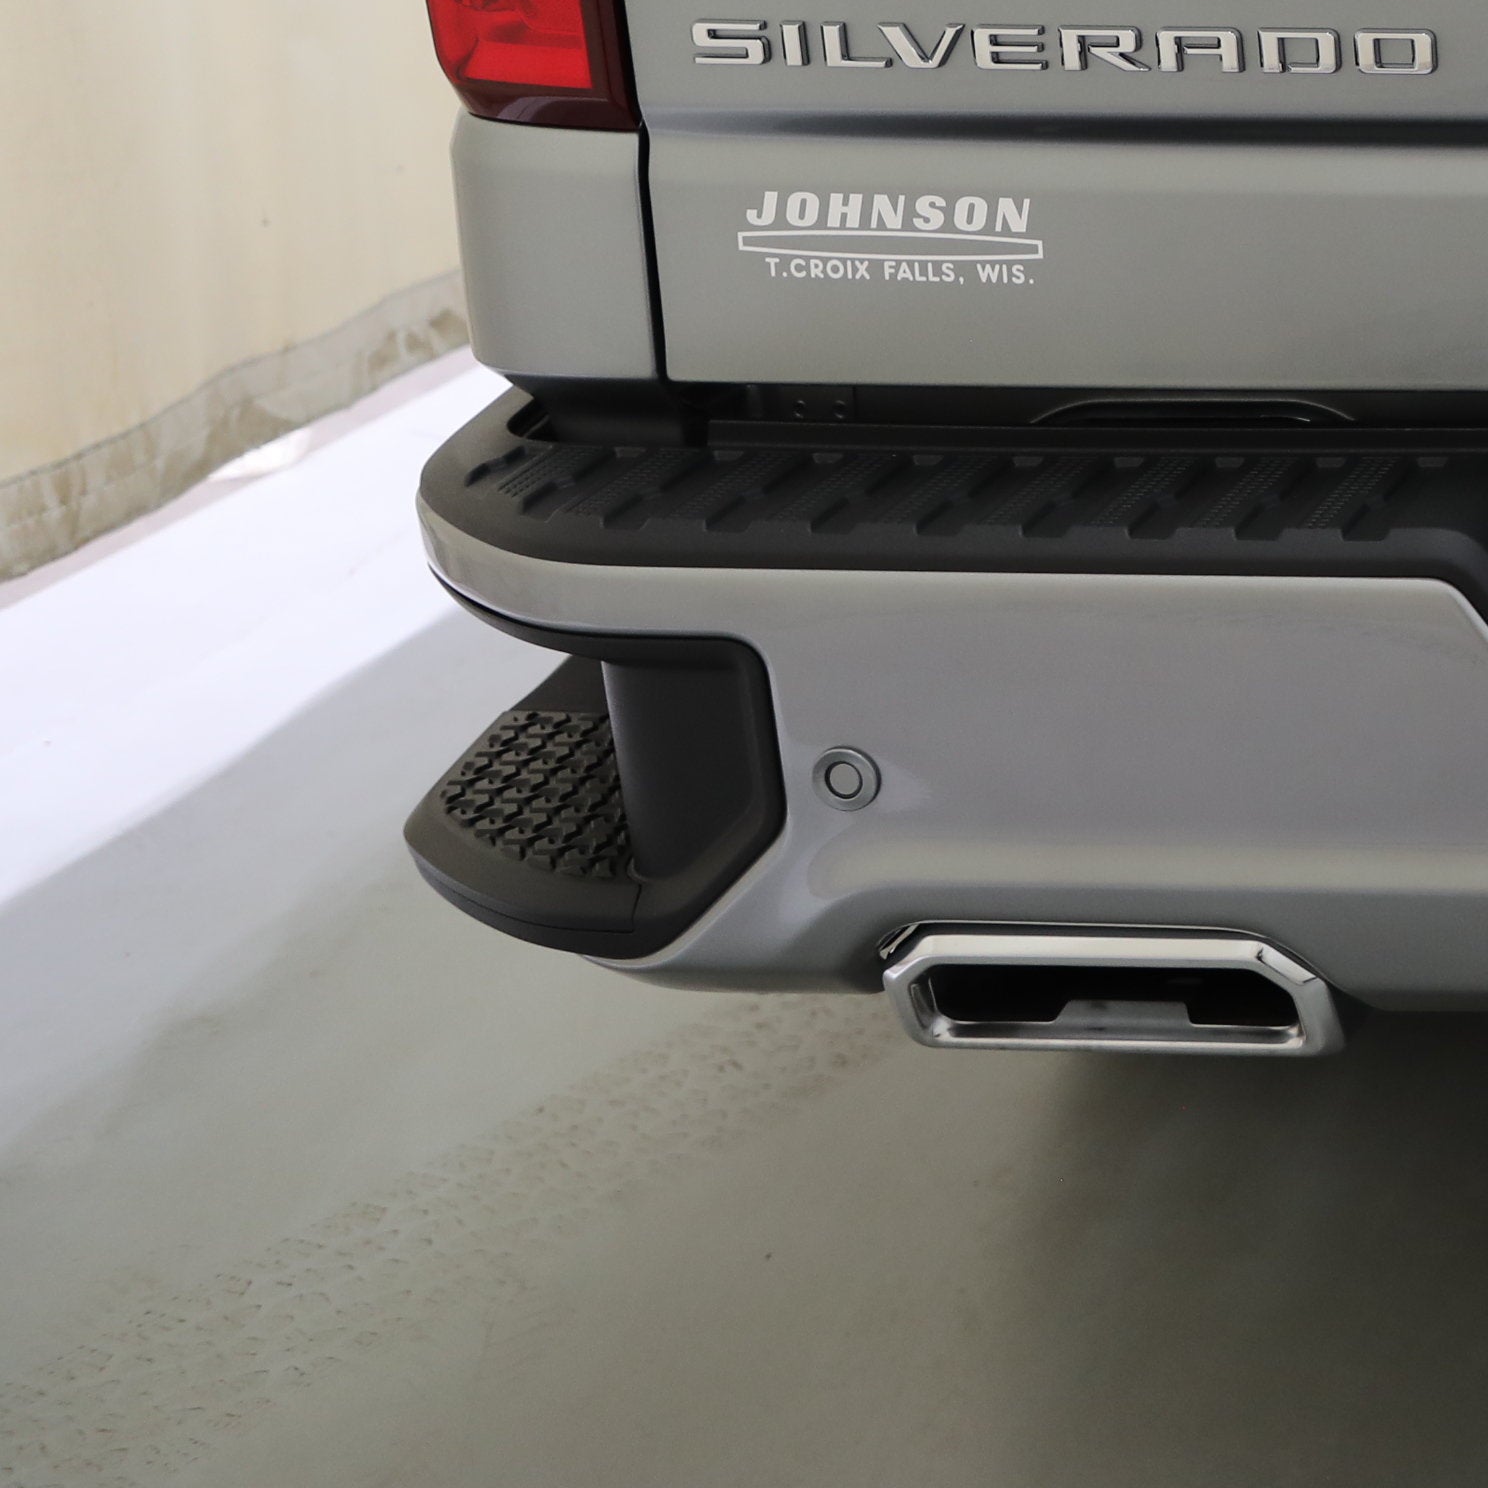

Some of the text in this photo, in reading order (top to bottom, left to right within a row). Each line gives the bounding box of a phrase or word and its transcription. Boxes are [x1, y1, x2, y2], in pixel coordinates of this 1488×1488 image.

[691, 18, 1439, 75] SILVERADO
[745, 190, 1032, 233] JOHNSON
[884, 260, 964, 285] FALLS,
[977, 263, 1036, 286] WIS.
